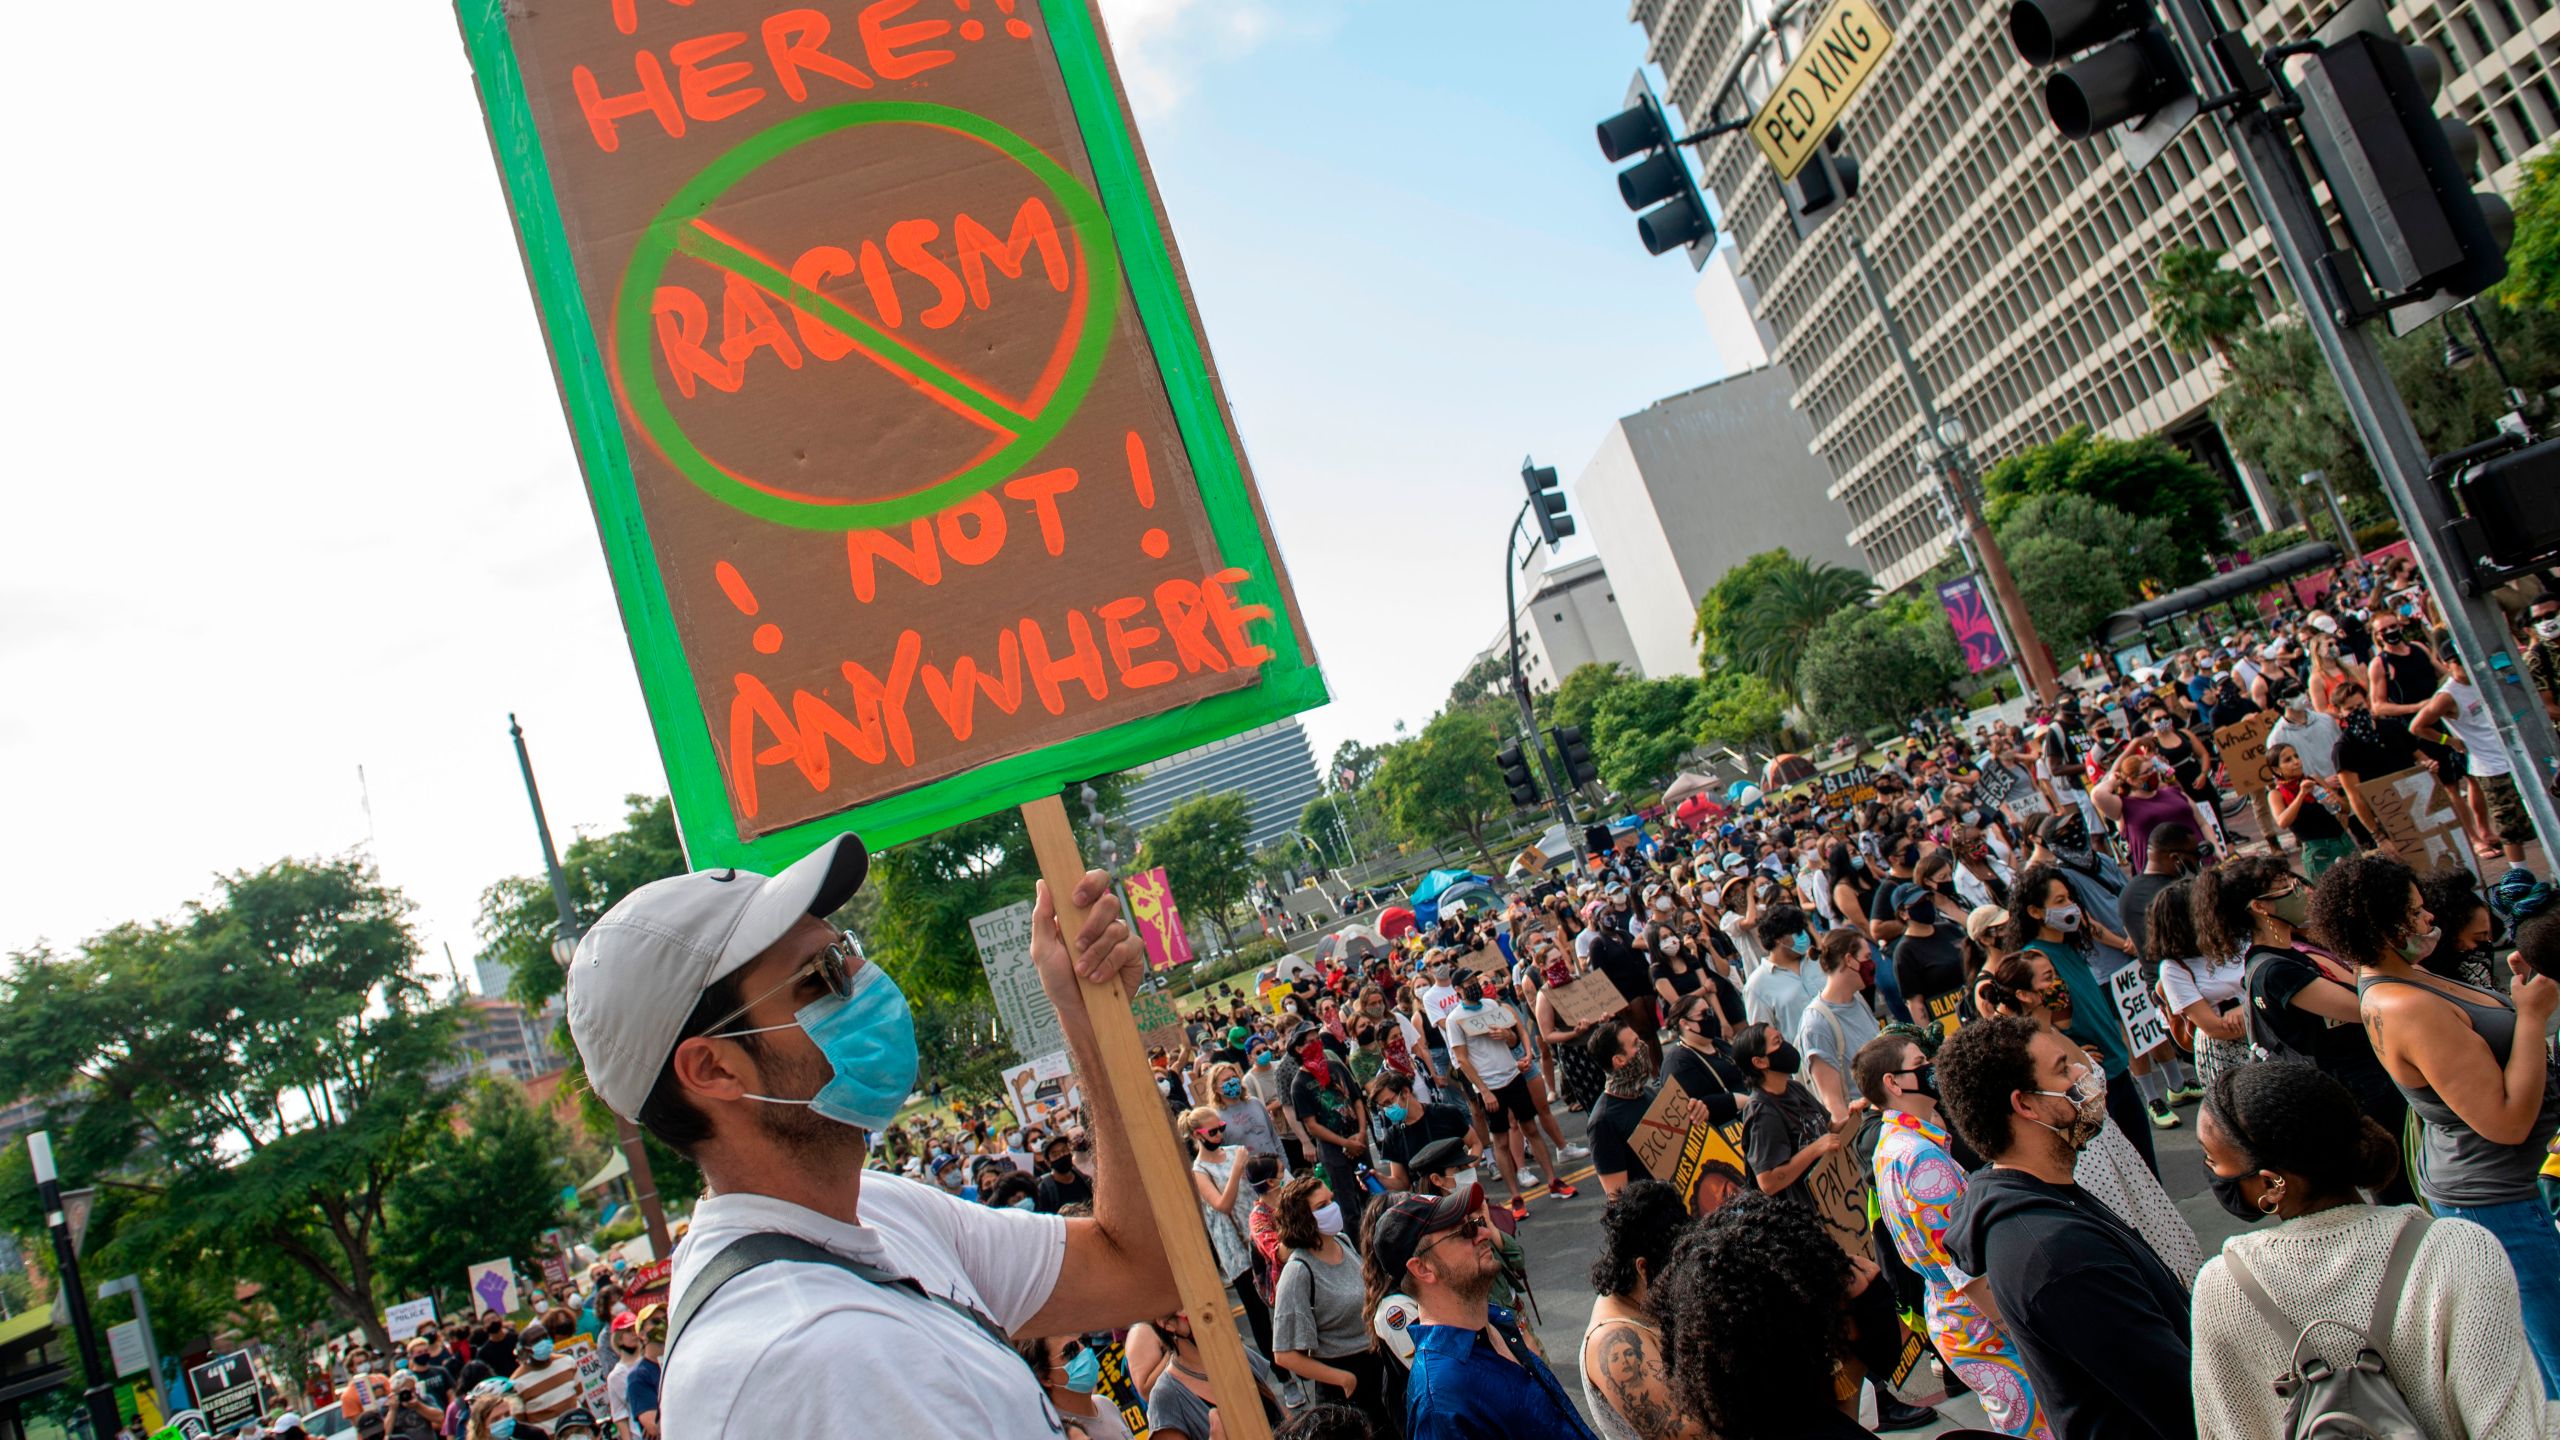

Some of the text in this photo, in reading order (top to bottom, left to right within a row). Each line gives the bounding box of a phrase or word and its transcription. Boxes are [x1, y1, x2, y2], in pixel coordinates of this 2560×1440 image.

[1764, 11, 1872, 159] PED XING
[651, 197, 1071, 398] RACISM
[847, 467, 1080, 604] NOT
[729, 568, 1278, 818] ANYWHERE
[2216, 724, 2258, 750] Which
[2241, 744, 2267, 761] are
[1823, 769, 1868, 794] BLM!
[1981, 770, 2007, 800] LIVES
[1988, 763, 2015, 790] BLACK
[2115, 969, 2138, 994] WE
[1439, 994, 1461, 1010] UN
[2121, 992, 2148, 1021] SEE
[1470, 1012, 1507, 1031] BLM
[1638, 1089, 1690, 1170] EXCUSES
[1674, 1156, 1695, 1196] LIVES
[1816, 1141, 1860, 1215] PAY AT
[1844, 1178, 1869, 1237] ST
[581, 1359, 602, 1377] BUR
[1121, 1405, 1147, 1431] TER
